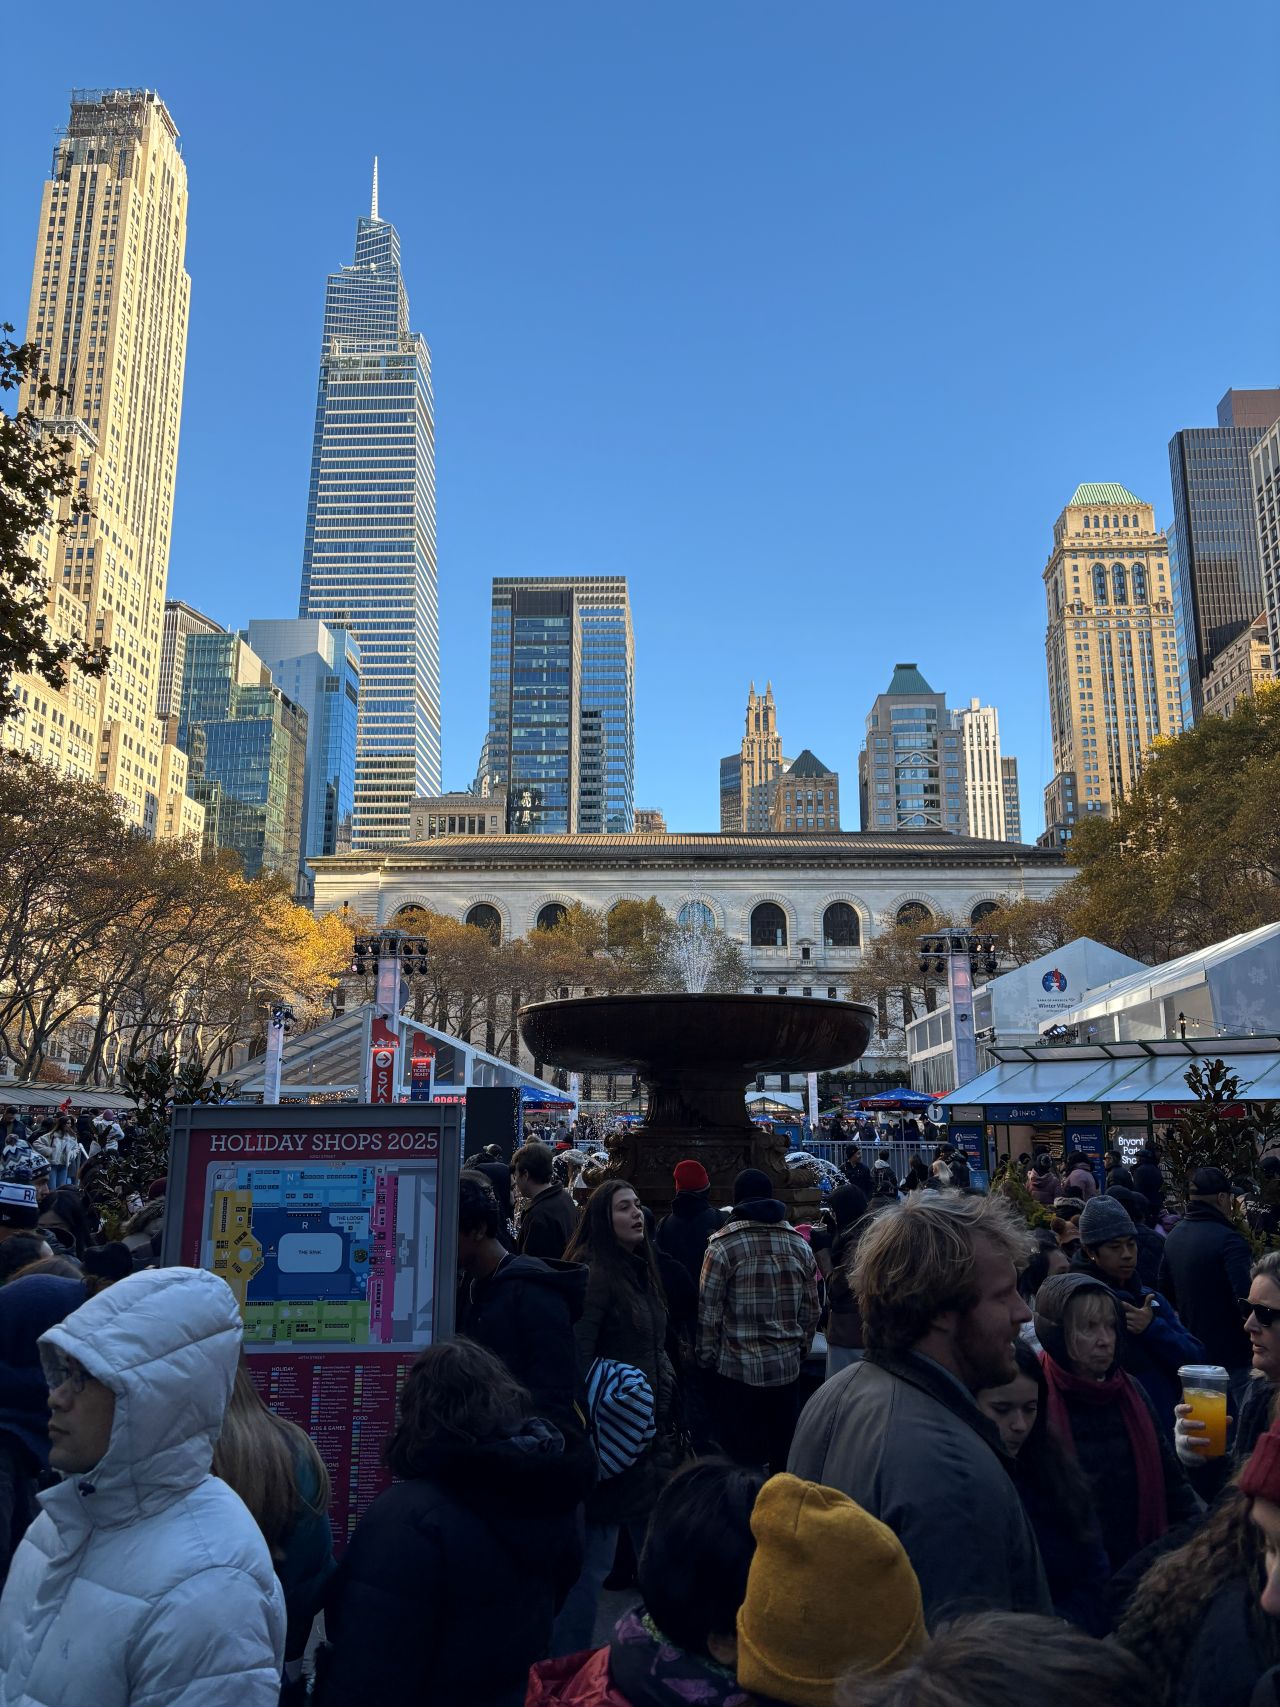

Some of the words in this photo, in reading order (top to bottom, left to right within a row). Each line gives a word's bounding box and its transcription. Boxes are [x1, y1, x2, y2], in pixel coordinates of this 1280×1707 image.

[210, 1134, 307, 1152] HOLIDAY
[312, 1133, 382, 1151] SHOPS
[387, 1132, 438, 1150] 2025
[1118, 1136, 1144, 1147] Bryant
[302, 1221, 309, 1230] R
[385, 1250, 392, 1258] E
